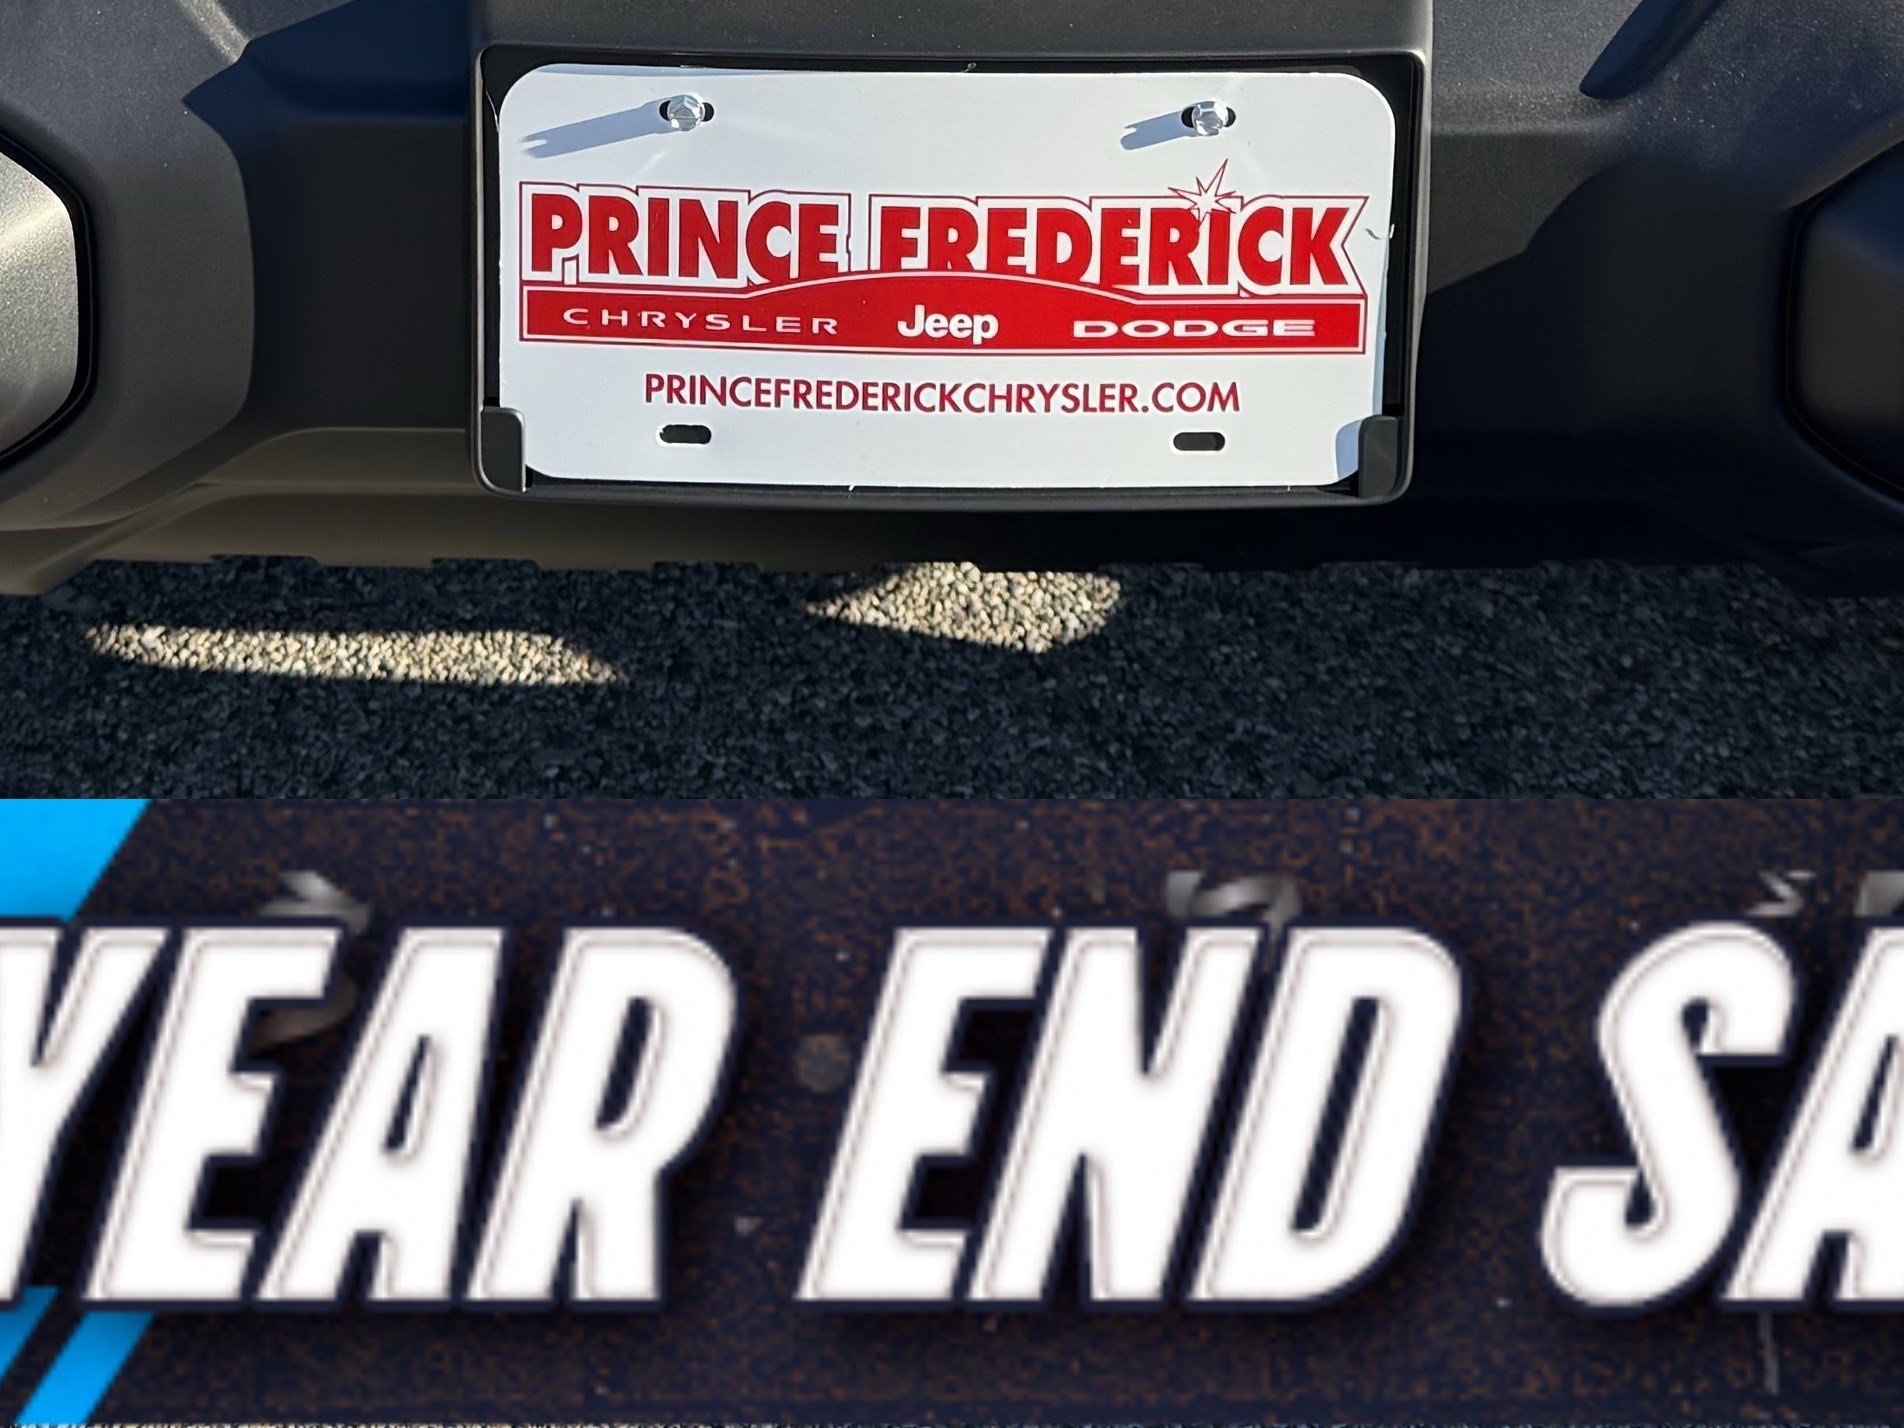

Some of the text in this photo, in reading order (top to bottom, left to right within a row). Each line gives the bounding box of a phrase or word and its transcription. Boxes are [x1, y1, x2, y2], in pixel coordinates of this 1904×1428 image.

[528, 194, 1351, 287] PRINCE FREDERICK
[561, 304, 1316, 345] CHRYSLER Jeep DODGE
[643, 372, 1242, 415] PRINCEFREDERICKCHRYSLER.COM
